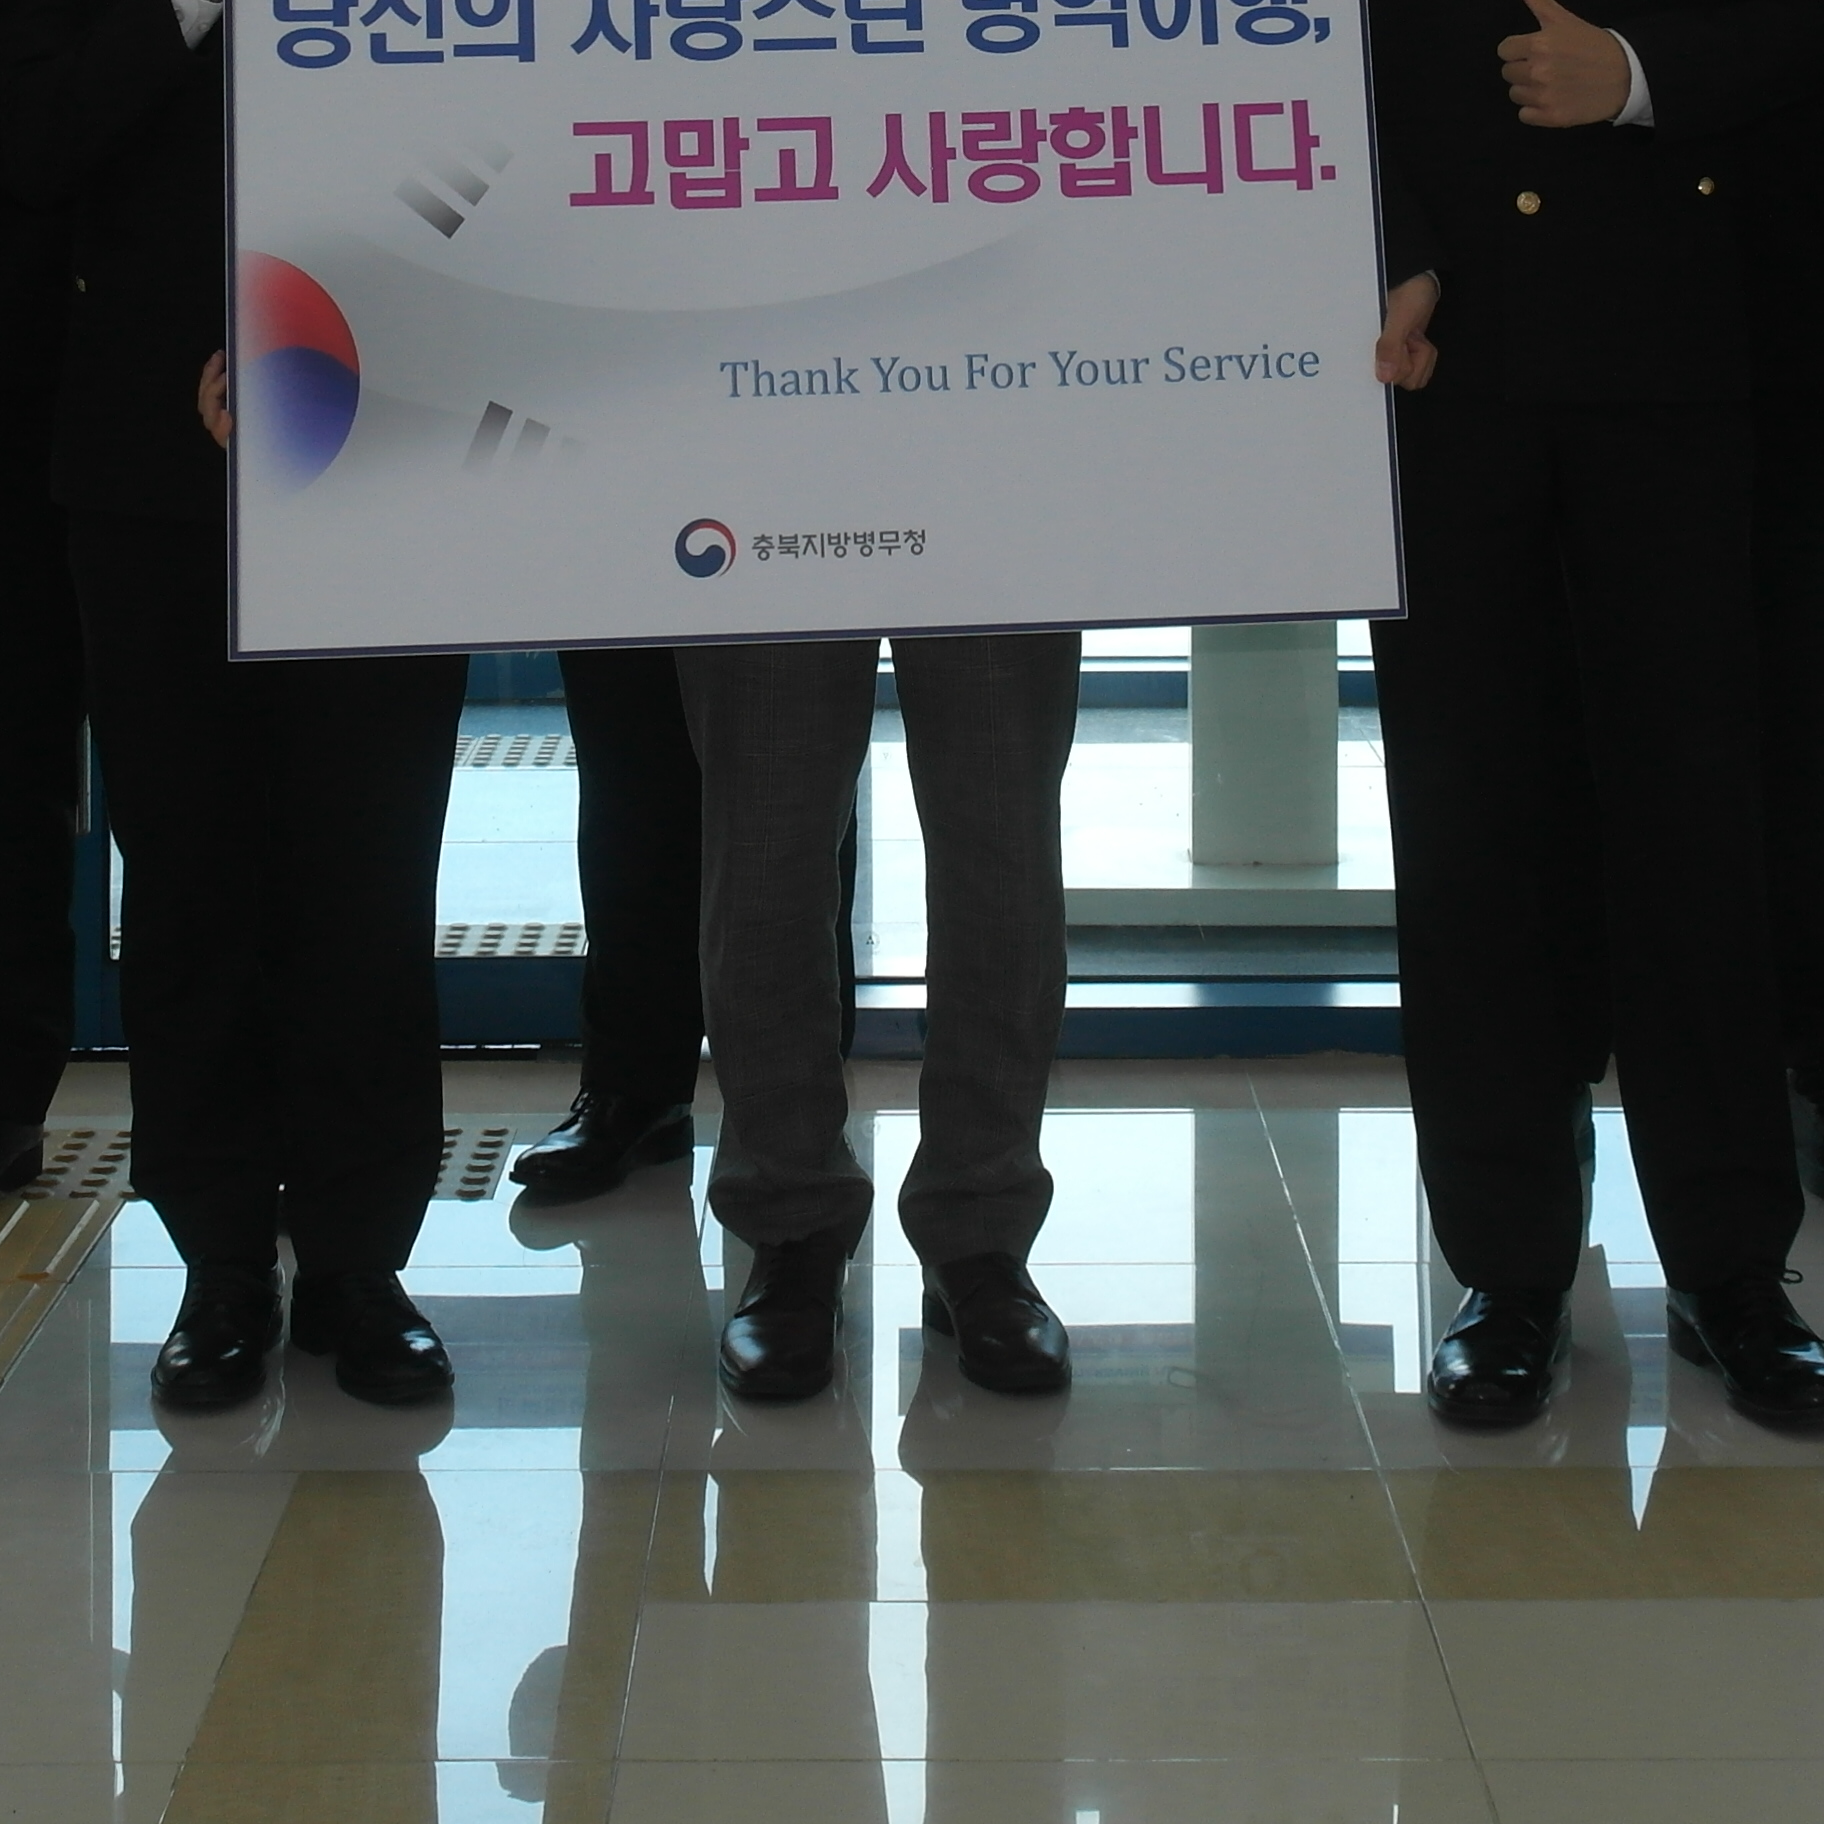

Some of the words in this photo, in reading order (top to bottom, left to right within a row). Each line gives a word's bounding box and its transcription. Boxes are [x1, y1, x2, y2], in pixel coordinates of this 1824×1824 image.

[569, 116, 839, 210] 고맙고
[866, 99, 1337, 204] 사랑합니다.
[720, 357, 859, 398] Thank
[872, 356, 949, 393] You
[966, 353, 1037, 390] For
[1049, 350, 1150, 387] Your
[1164, 343, 1320, 383] Service
[752, 529, 926, 559] 충북지방병무청
